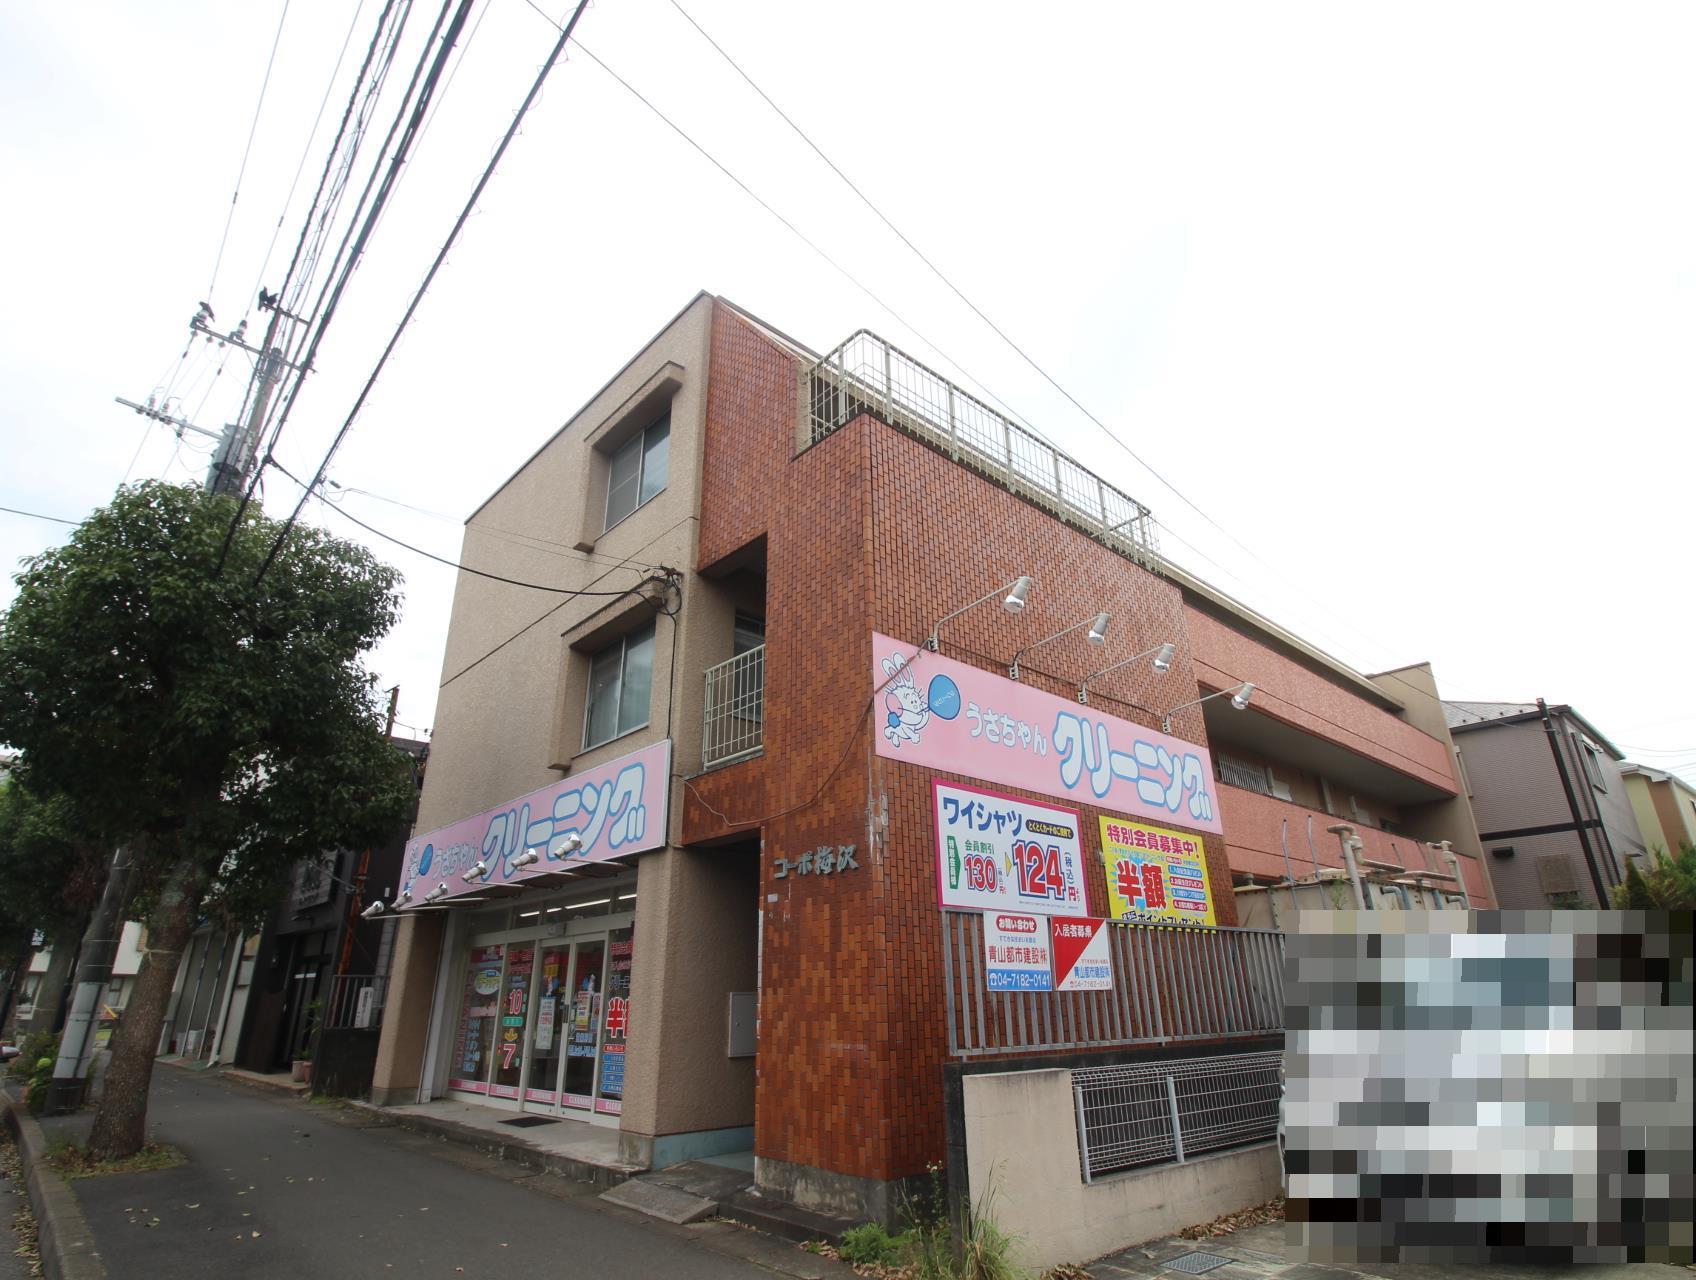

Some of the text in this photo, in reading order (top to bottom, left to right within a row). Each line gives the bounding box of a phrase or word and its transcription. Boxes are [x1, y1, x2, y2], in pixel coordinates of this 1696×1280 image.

[965, 701, 1212, 821] うさちゃん クリーニング
[481, 762, 646, 882] クリーニング
[943, 797, 1022, 837] ワイシャツ
[965, 840, 994, 855] 会員割引
[1107, 824, 1200, 859] 特別会員募集中!
[774, 844, 860, 879] コーポ梅沢
[964, 854, 998, 892] 130
[1012, 839, 1066, 901] 124
[1117, 860, 1167, 910] 半額
[999, 918, 1035, 931] お問い合わせ
[1055, 924, 1093, 938] 入居者募集
[997, 973, 1050, 988] 04-7182-0141
[509, 989, 523, 1015] 10
[605, 997, 630, 1039] 半
[503, 1044, 517, 1069] 7
